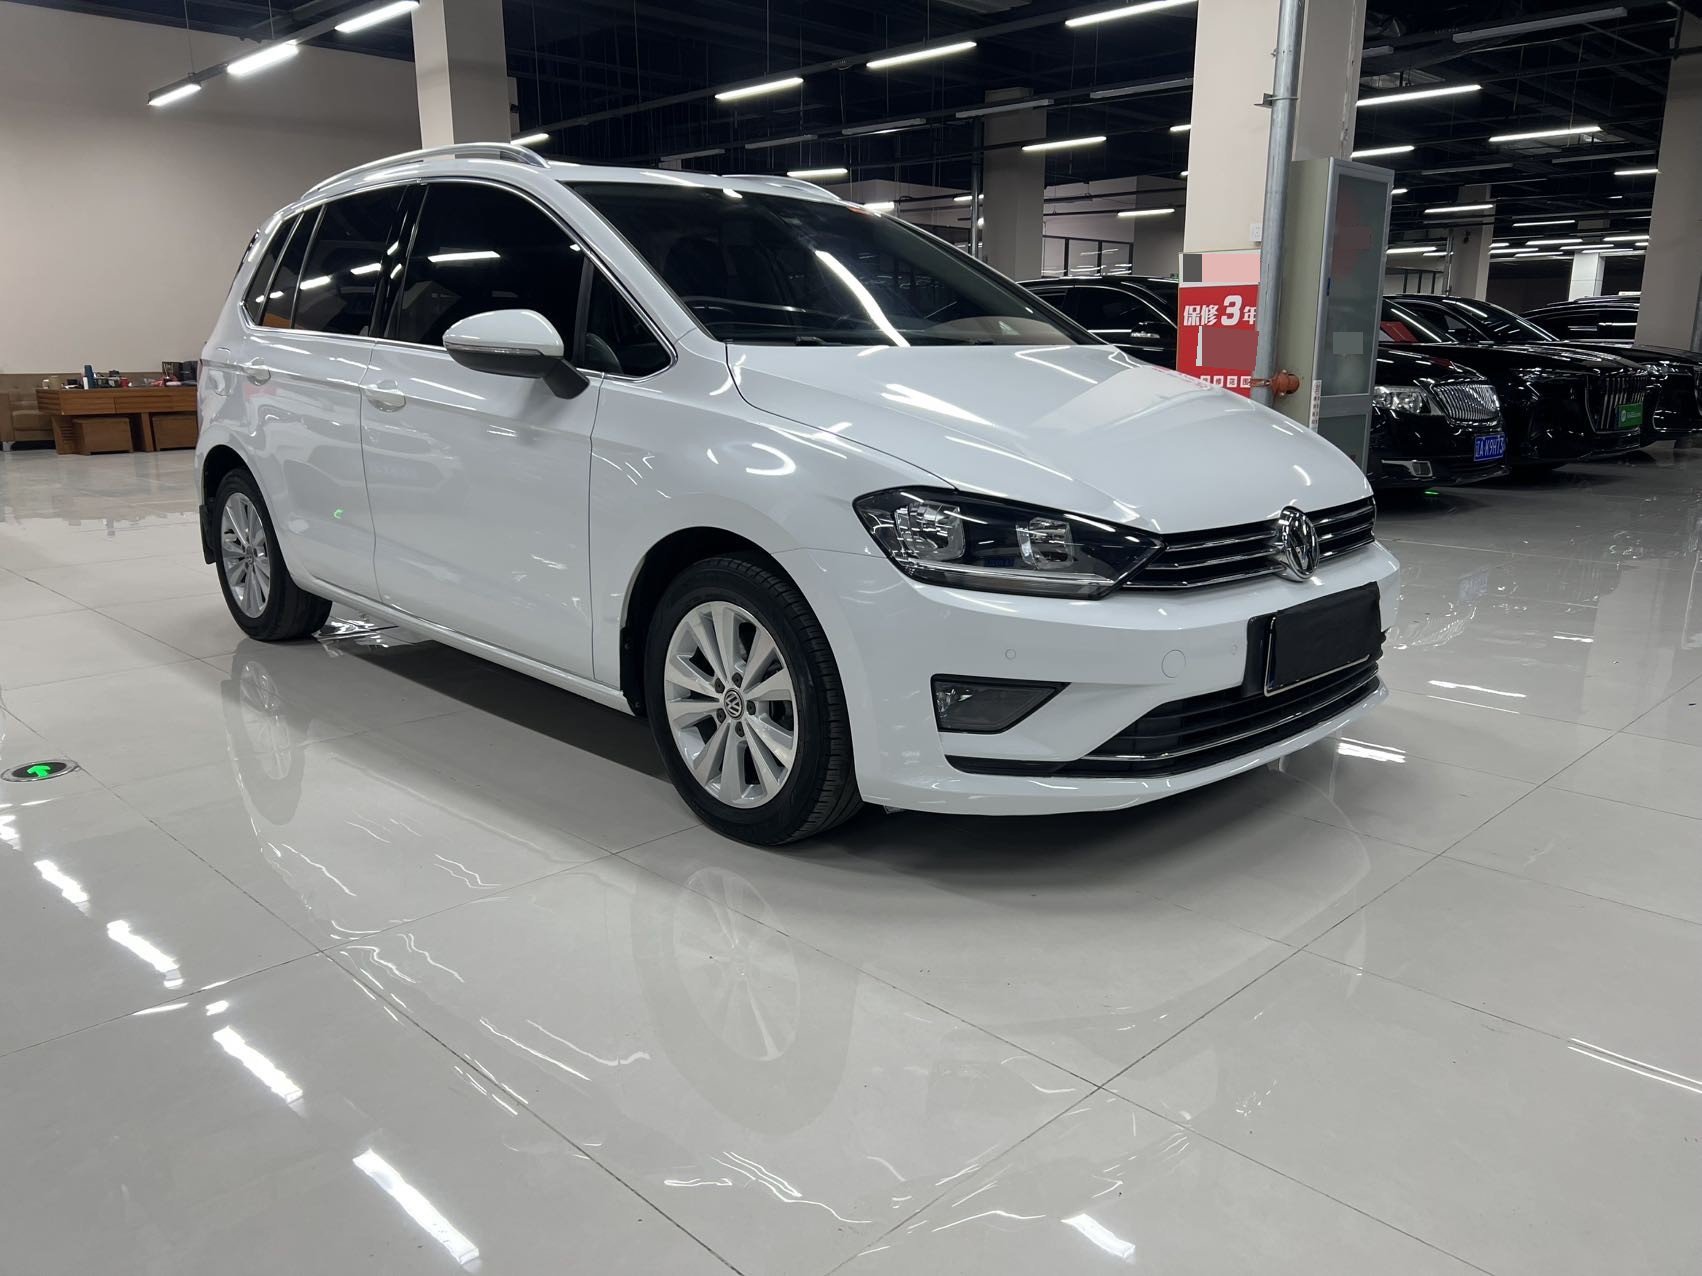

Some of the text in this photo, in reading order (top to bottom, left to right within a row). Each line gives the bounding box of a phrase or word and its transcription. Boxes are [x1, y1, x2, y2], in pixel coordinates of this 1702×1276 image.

[1183, 295, 1257, 326] 保修3年
[725, 691, 743, 718] VW
